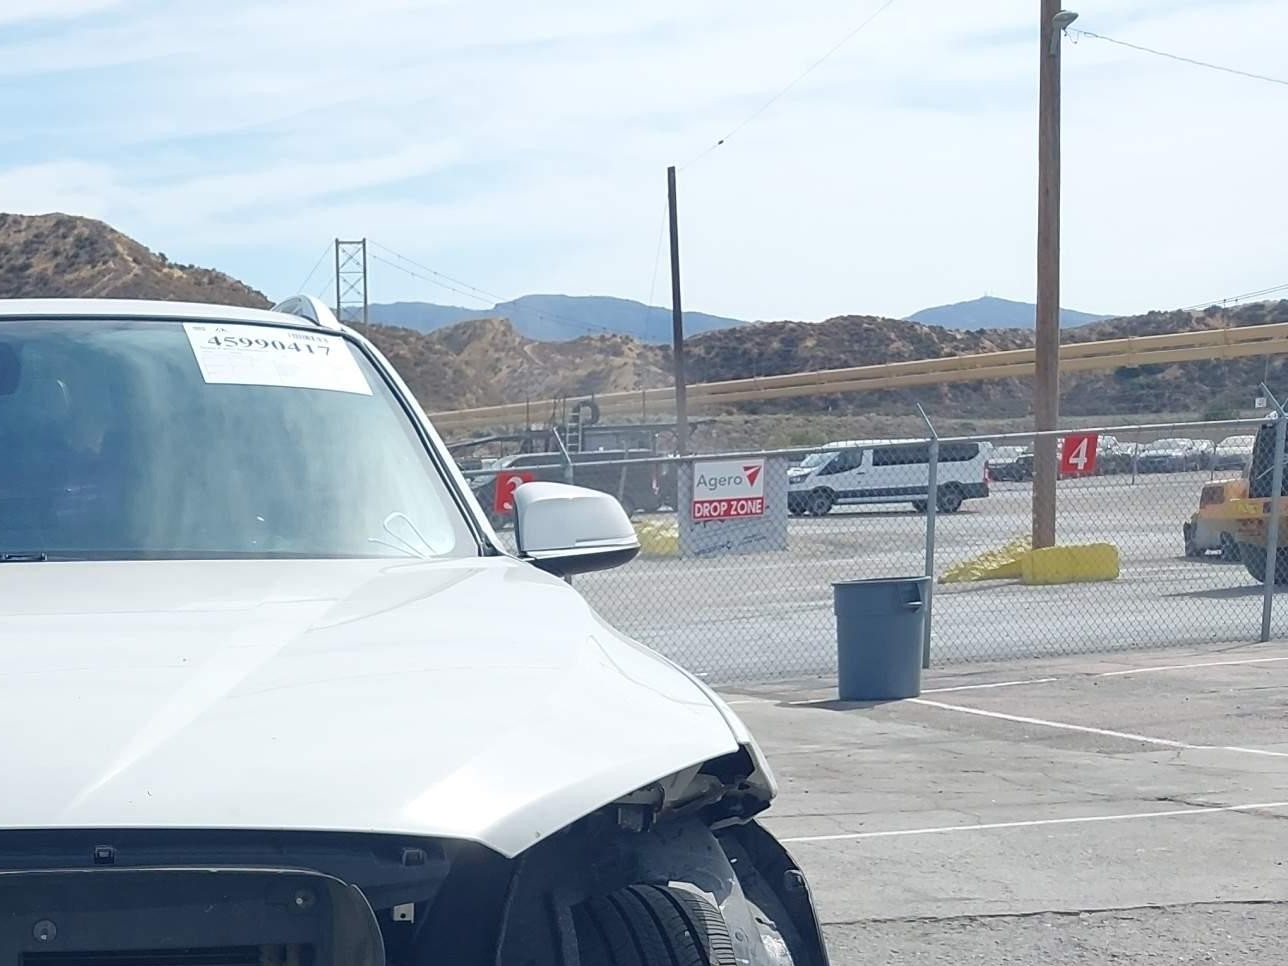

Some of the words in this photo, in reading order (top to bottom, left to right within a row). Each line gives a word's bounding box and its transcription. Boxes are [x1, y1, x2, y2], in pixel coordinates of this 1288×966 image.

[207, 335, 330, 356] 45990417
[1068, 437, 1088, 470] 4
[696, 474, 743, 491] Agero
[694, 501, 728, 517] DROP
[730, 499, 762, 515] ZONE
